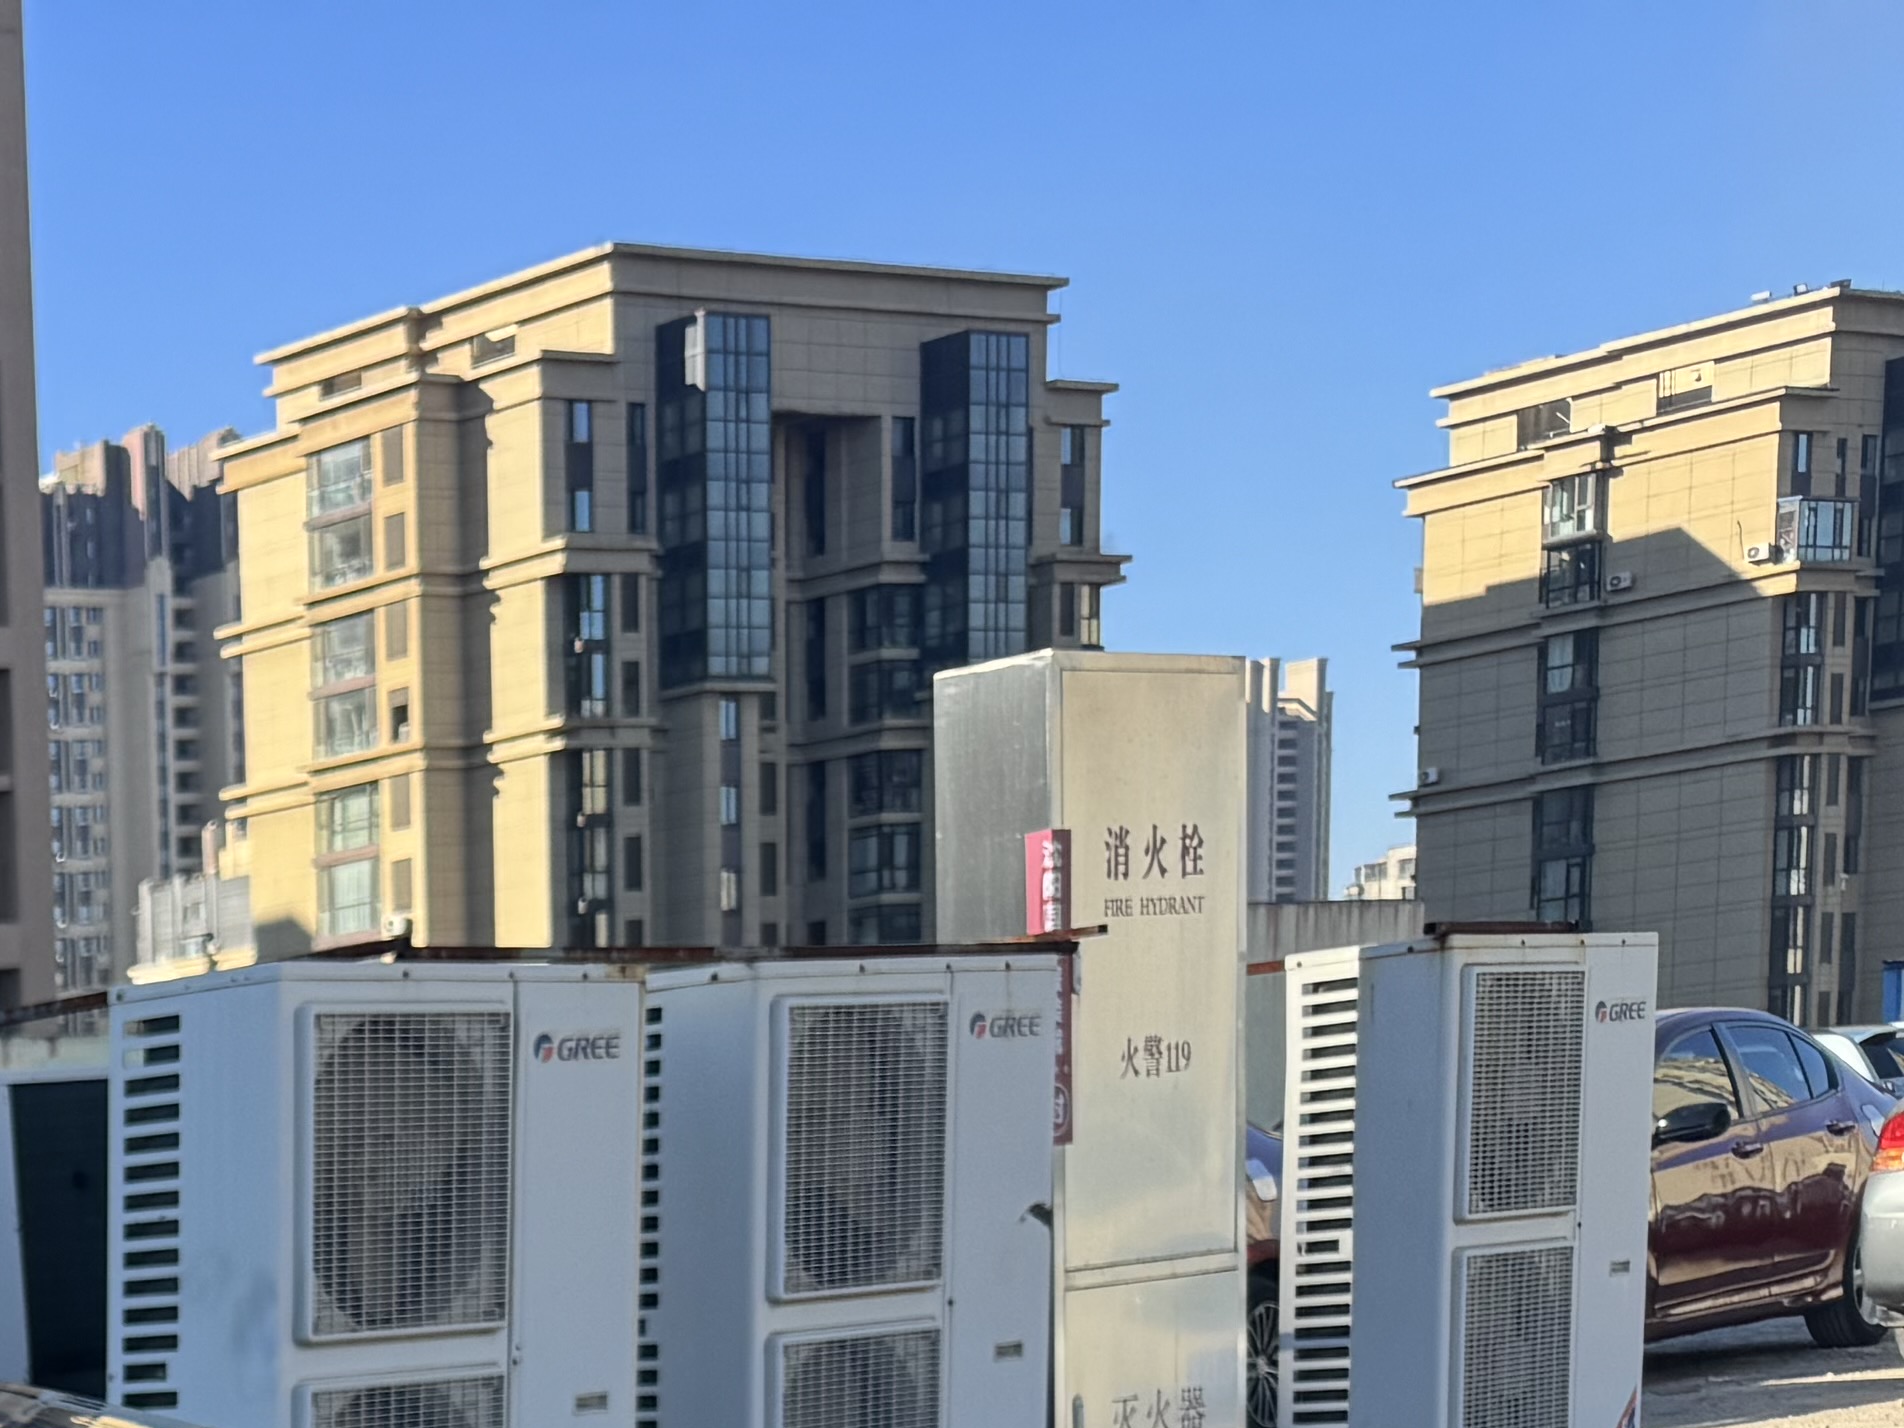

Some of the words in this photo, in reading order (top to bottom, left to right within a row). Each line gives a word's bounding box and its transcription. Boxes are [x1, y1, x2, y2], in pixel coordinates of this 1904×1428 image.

[1104, 824, 1206, 881] 消火栓
[1104, 897, 1134, 918] FIRE
[1140, 896, 1205, 916] HYDRANT
[1609, 1001, 1647, 1022] GREE
[989, 1016, 1042, 1038] GREE
[557, 1035, 621, 1062] GREE
[1120, 1035, 1192, 1080] 火警119
